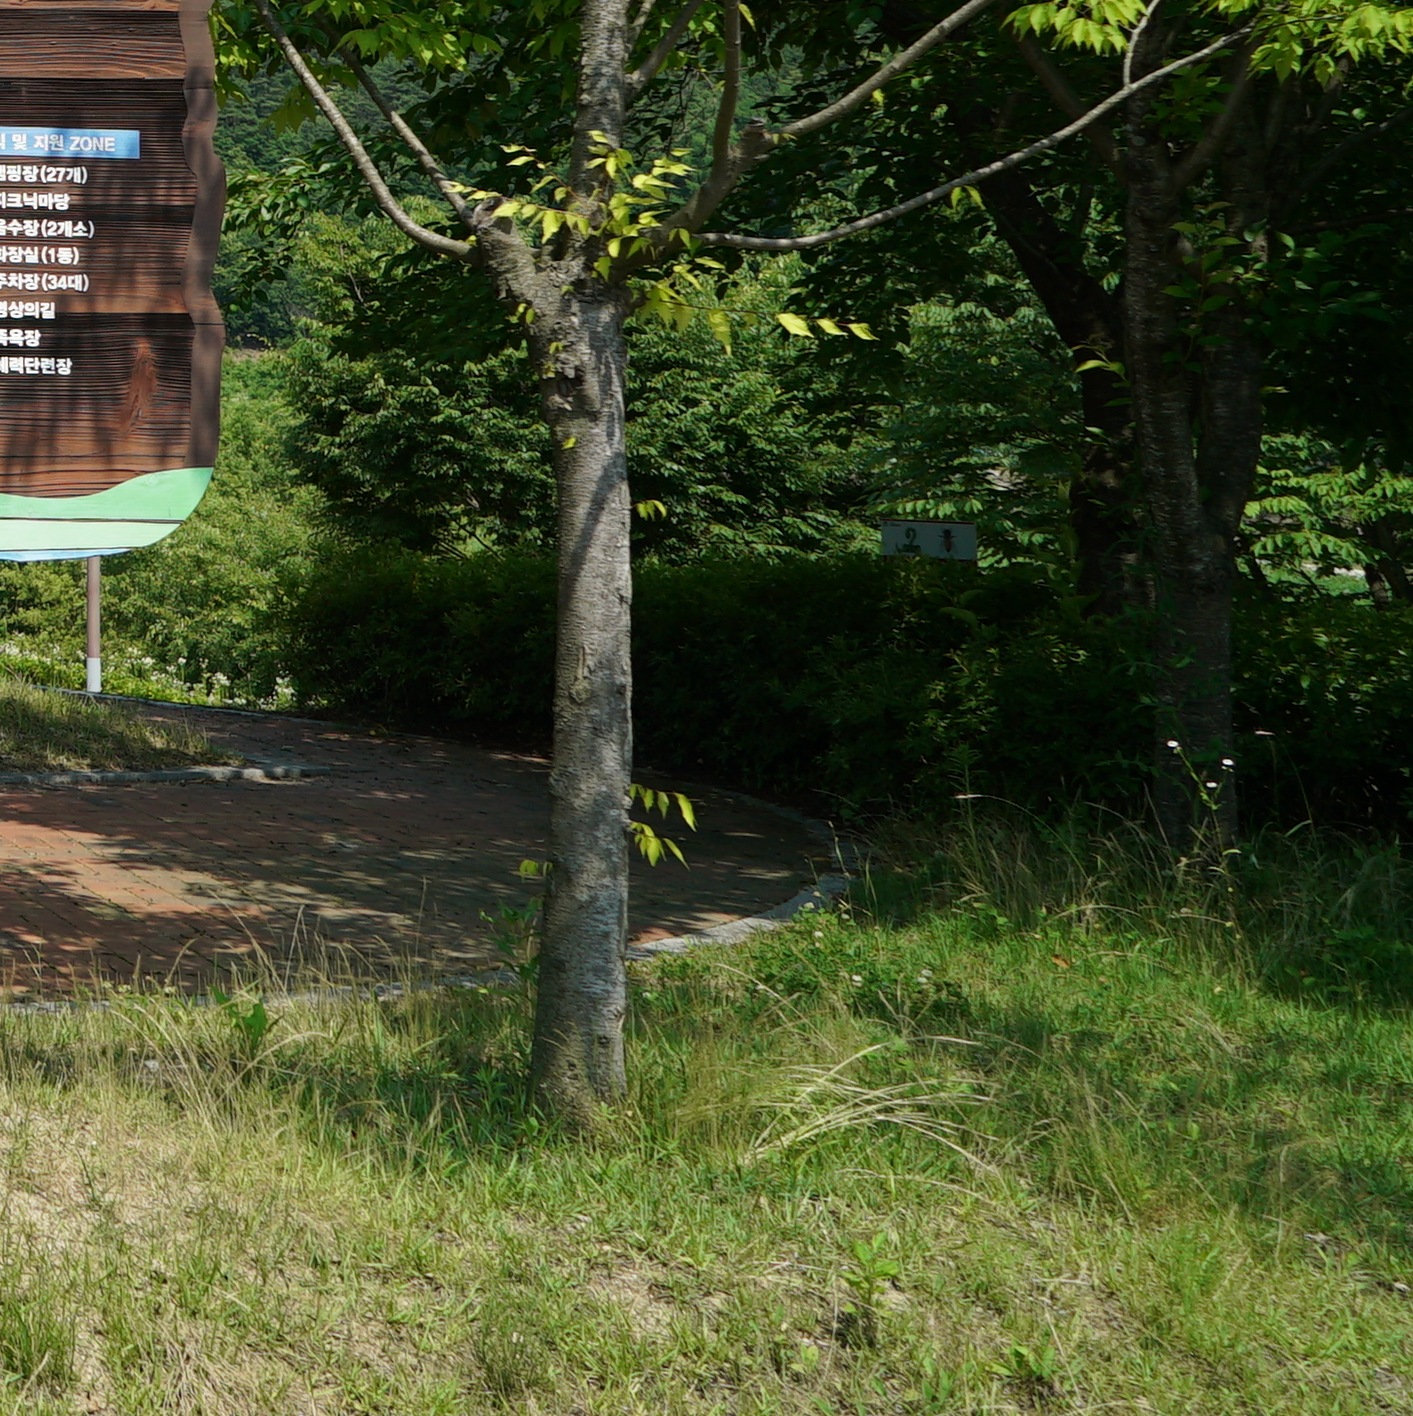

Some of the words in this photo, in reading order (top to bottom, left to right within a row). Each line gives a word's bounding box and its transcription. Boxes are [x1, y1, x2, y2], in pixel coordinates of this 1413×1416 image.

[12, 133, 27, 150] 및
[33, 134, 64, 151] 지원
[69, 137, 115, 152] ZONE
